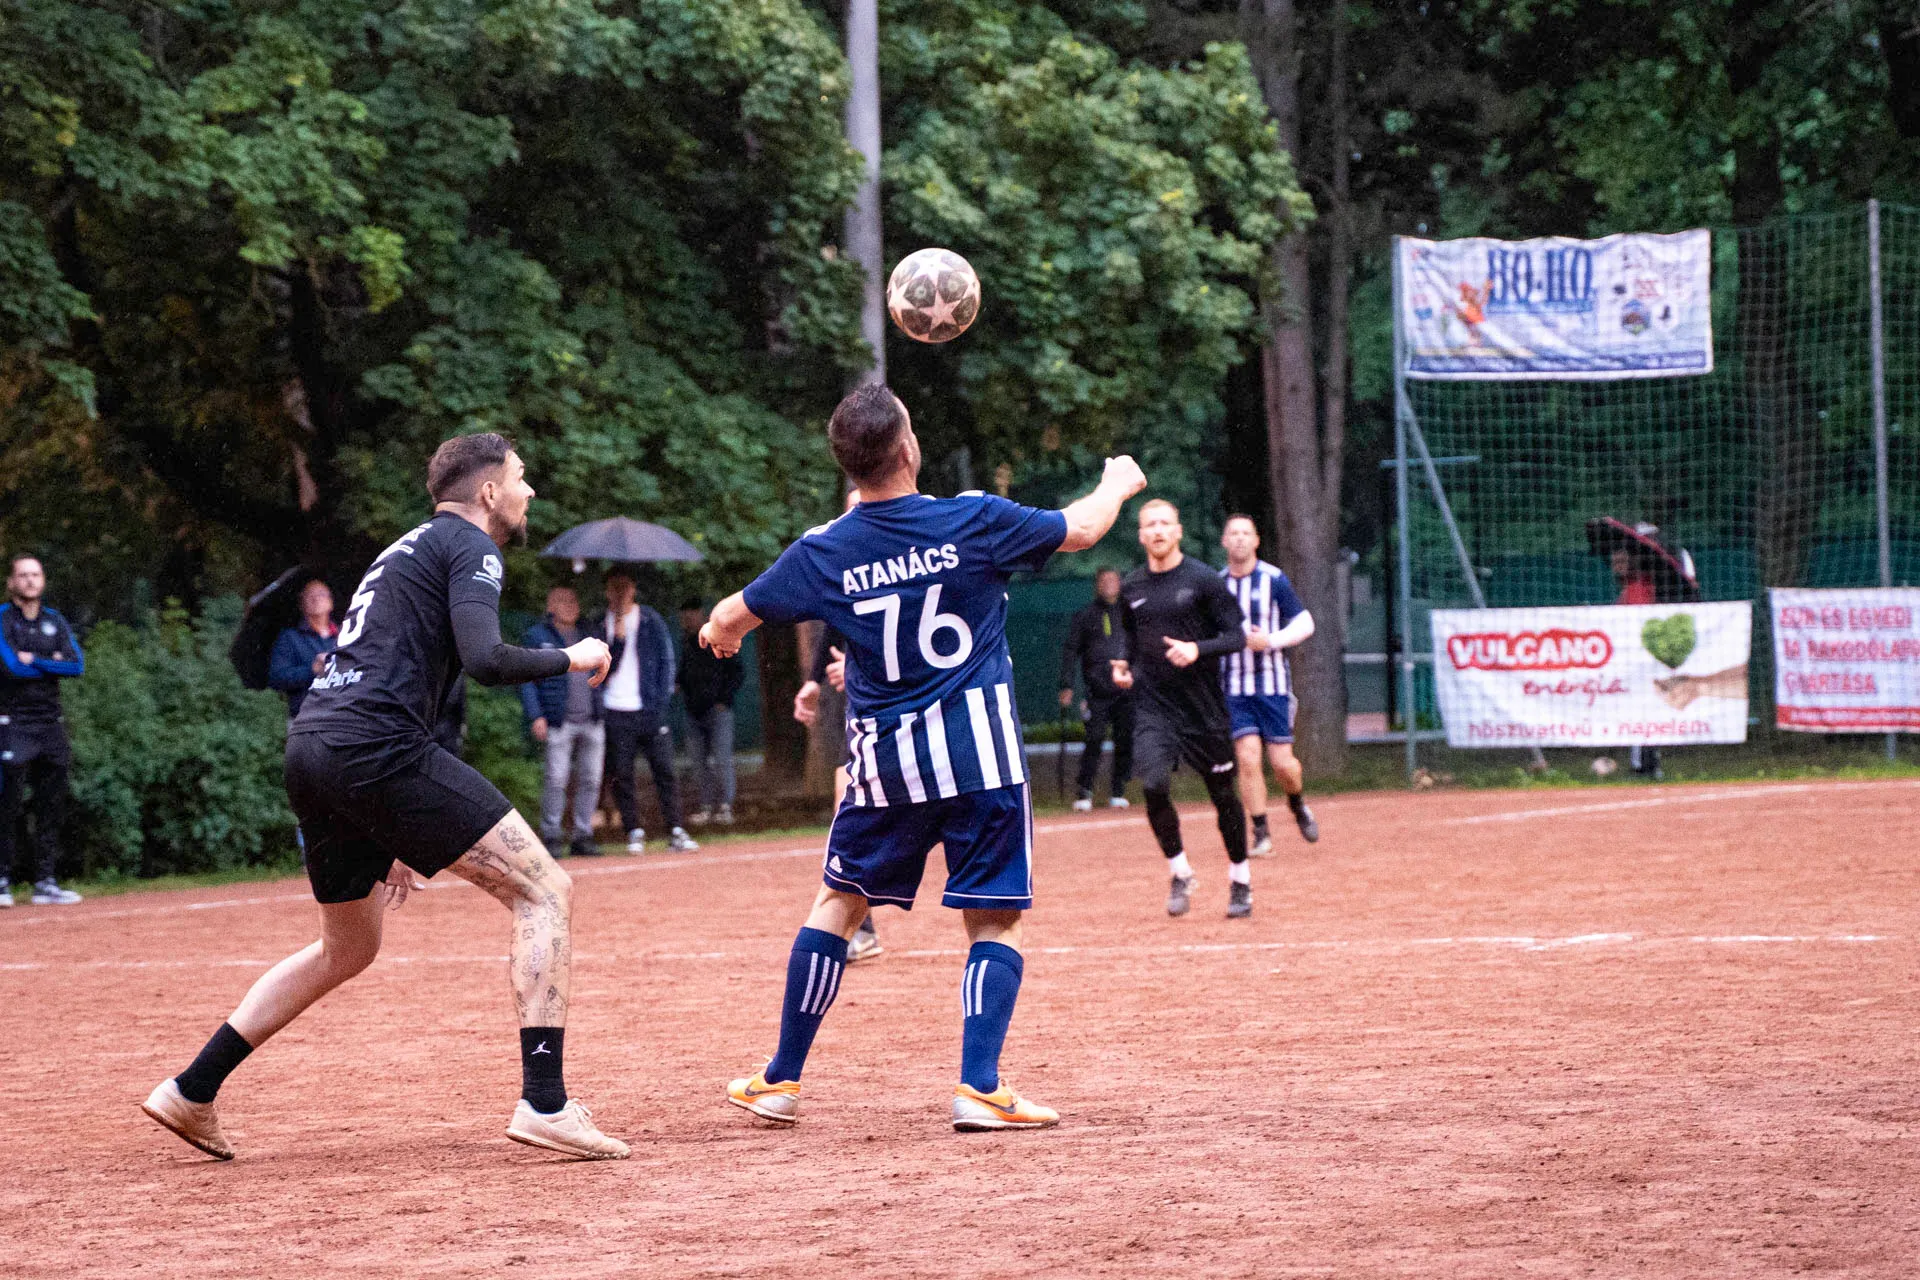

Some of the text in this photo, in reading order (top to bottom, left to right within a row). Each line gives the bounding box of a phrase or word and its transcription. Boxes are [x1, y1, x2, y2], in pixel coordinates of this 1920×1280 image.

[843, 543, 960, 595] ATANÁCS
[852, 583, 973, 682] 76
[1450, 636, 1608, 668] VULCANO
[1523, 675, 1628, 706] energia
